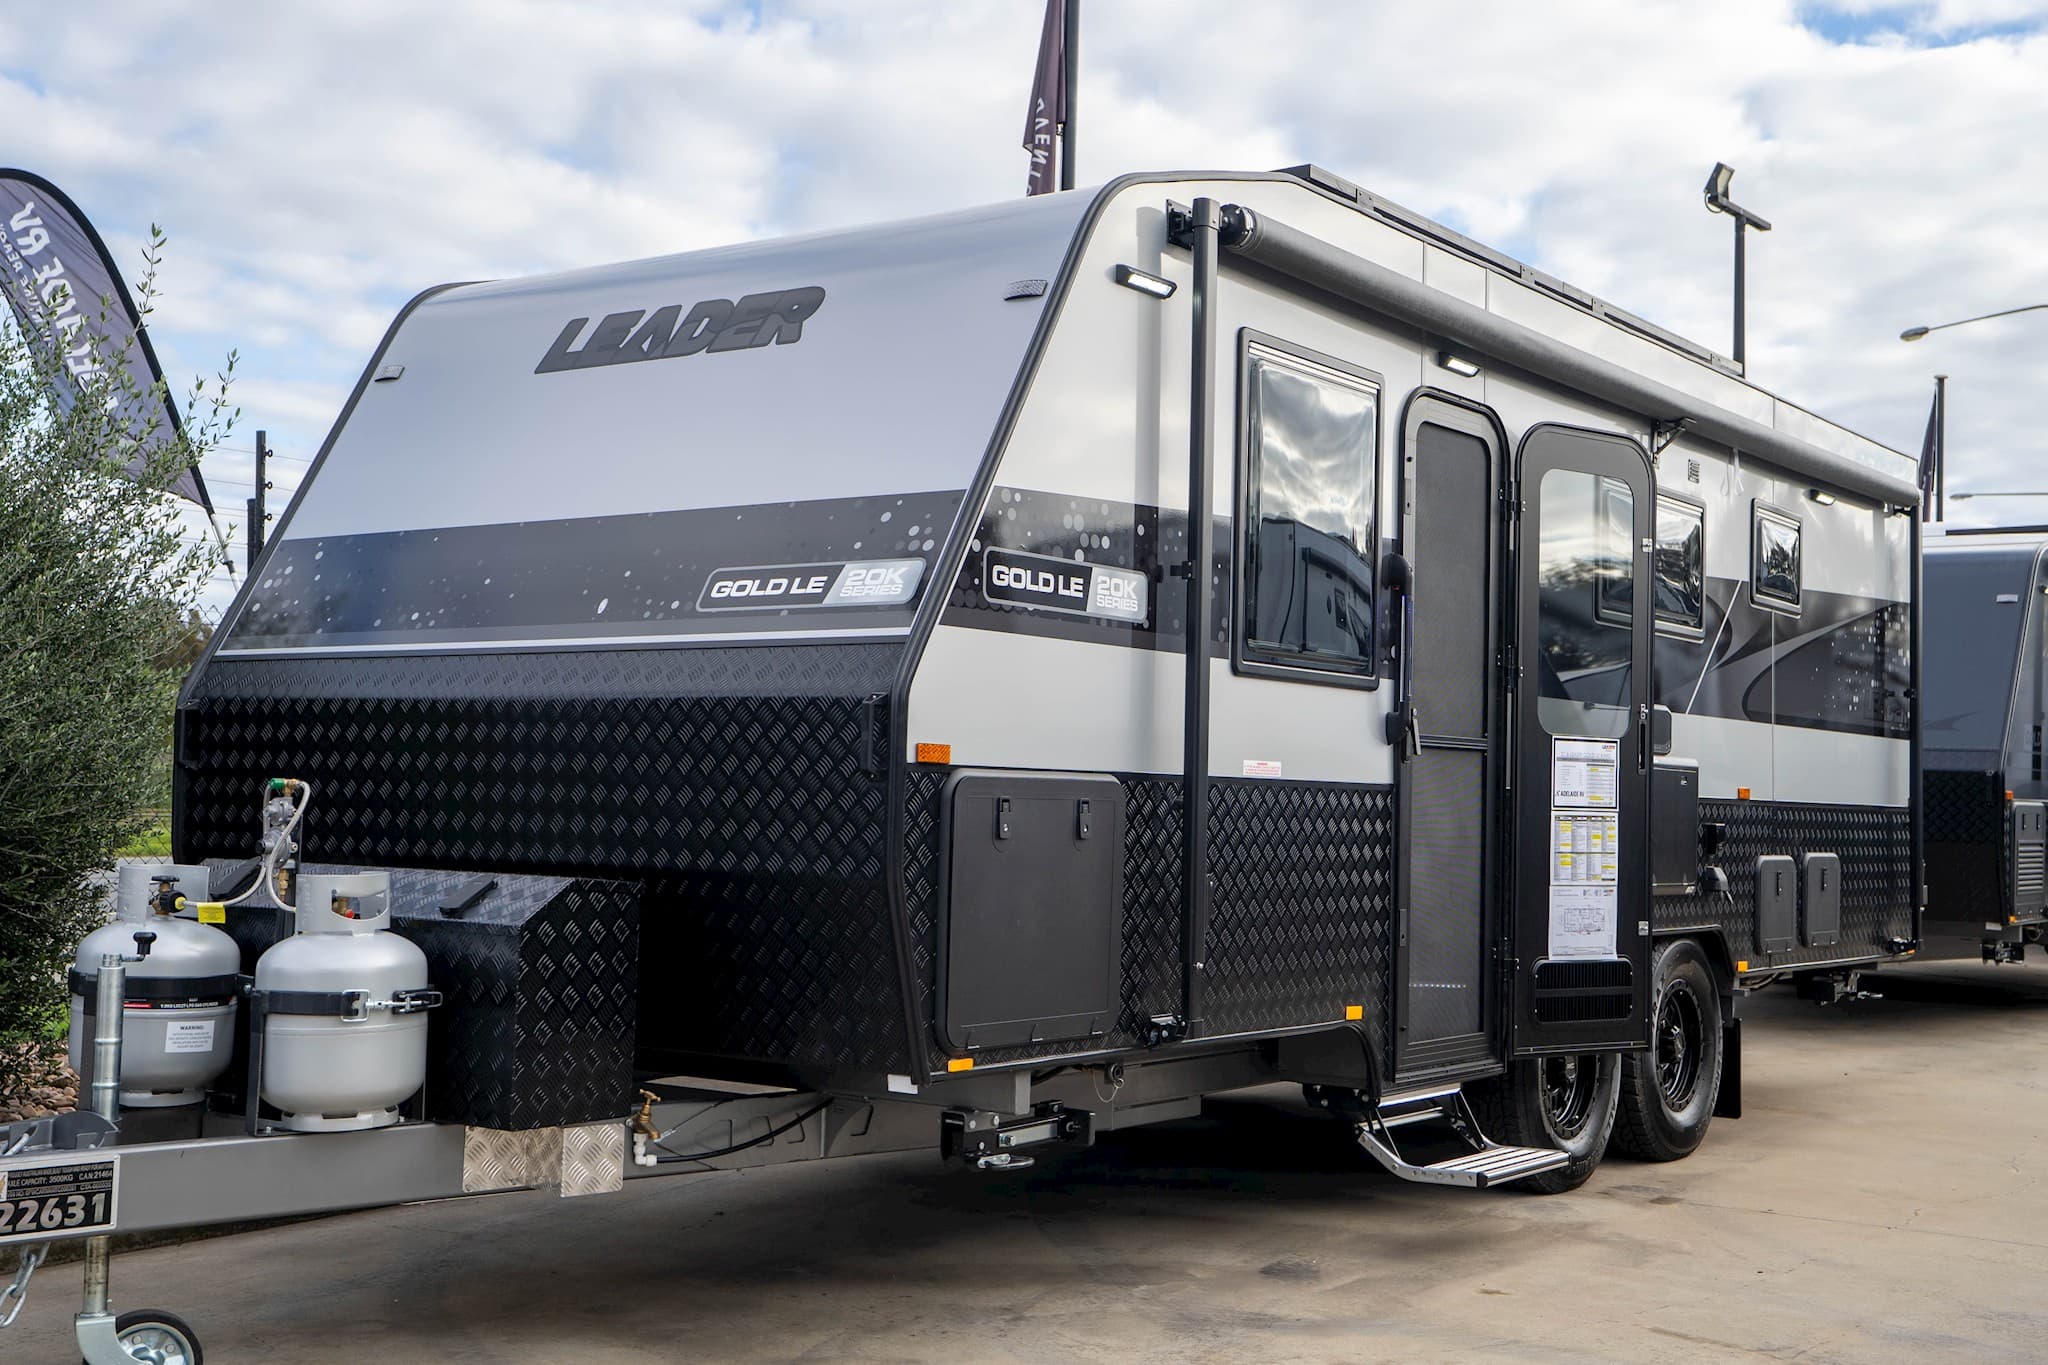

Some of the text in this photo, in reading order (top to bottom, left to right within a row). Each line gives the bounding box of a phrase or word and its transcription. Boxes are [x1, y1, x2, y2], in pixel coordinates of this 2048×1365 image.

[534, 286, 826, 374] LEADER
[711, 576, 828, 598] GOLD LE
[846, 568, 908, 585] 20K
[992, 565, 1084, 598] GOLD LE
[1096, 576, 1138, 599] 20K
[839, 584, 903, 597] SERIES
[1096, 595, 1138, 612] SERIES
